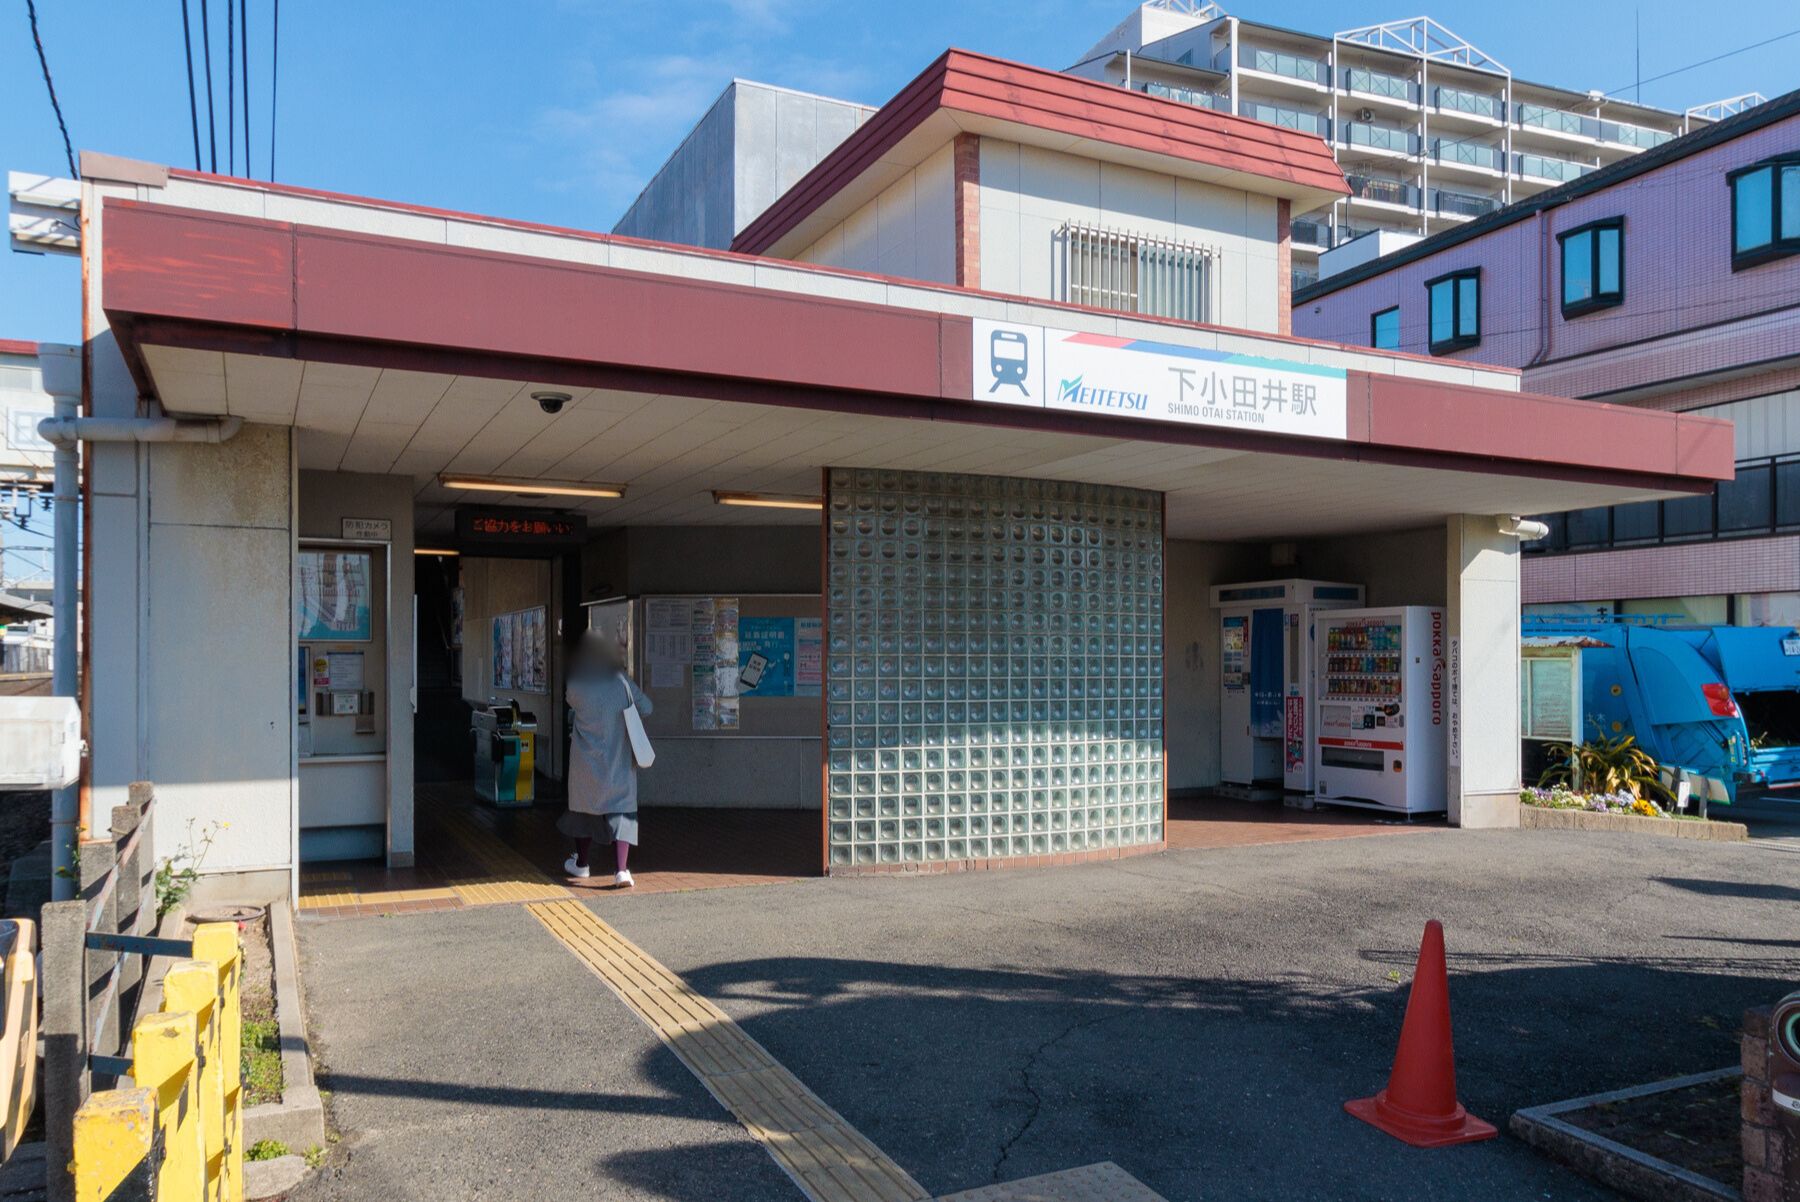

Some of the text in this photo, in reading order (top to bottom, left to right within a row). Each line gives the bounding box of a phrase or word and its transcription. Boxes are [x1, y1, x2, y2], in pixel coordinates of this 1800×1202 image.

[1058, 373, 1148, 411] MEITETSU
[1168, 367, 1316, 416] 下小田井駅
[1167, 402, 1265, 424] SHIMO OTAI STATION
[1430, 612, 1442, 656] pokka
